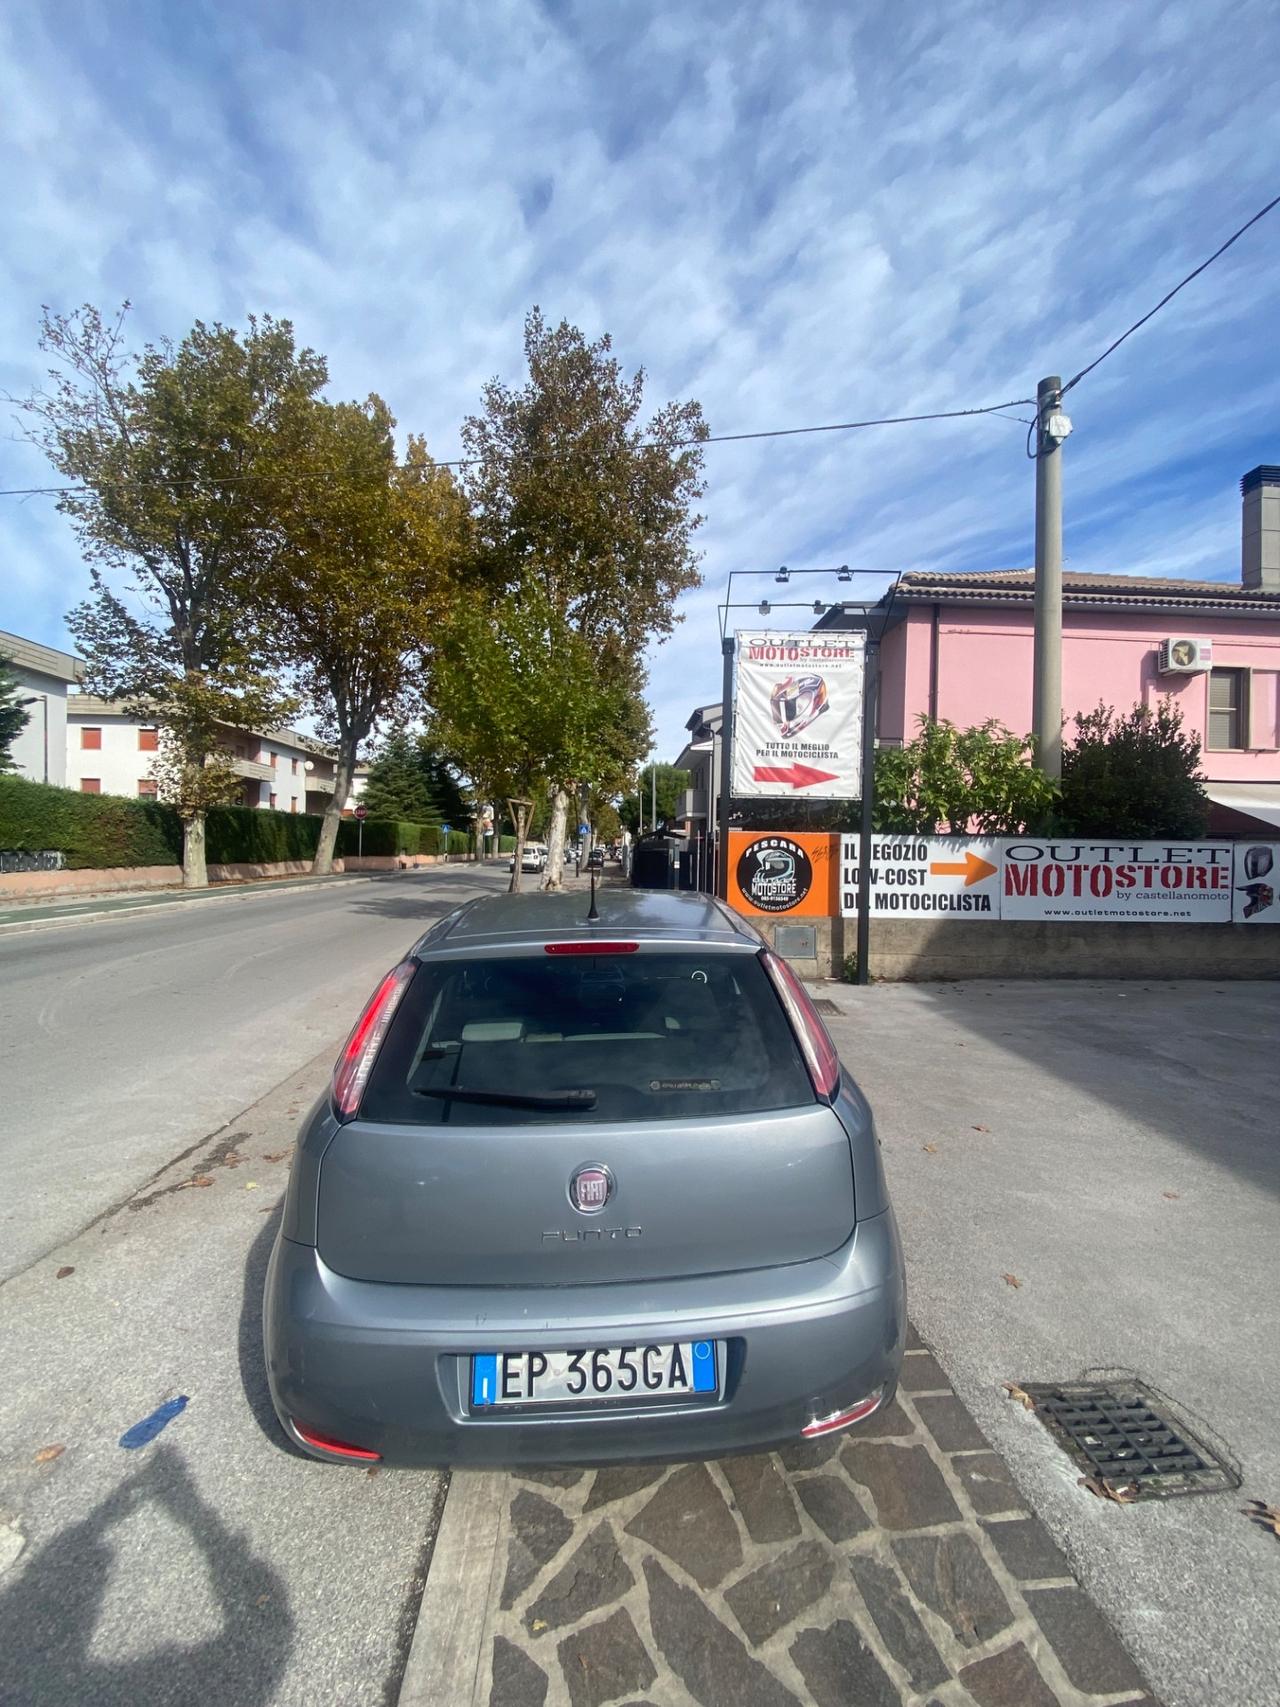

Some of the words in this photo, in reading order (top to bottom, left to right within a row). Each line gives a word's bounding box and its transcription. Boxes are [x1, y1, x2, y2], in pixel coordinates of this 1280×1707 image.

[749, 638, 855, 648] OUTLET
[749, 646, 855, 661] MOTOSTORE
[756, 749, 771, 757] PER
[781, 750, 839, 759] MOTOCICLISTA
[766, 742, 790, 750] TUTTO
[800, 743, 830, 751] MEGLIO
[745, 839, 804, 858] PESCARA
[844, 844, 858, 860] IL
[871, 843, 928, 861] EGOZIO
[1005, 845, 1230, 864] OUTLET
[1005, 863, 1230, 898] MOTOSTORE
[751, 883, 797, 896] MOTOSTORE
[1116, 890, 1131, 901] by
[1136, 889, 1230, 901] castellanomoto
[875, 893, 991, 912] MOTOCICLISTA
[1044, 909, 1192, 917] www.outletmotostore.net
[580, 1179, 604, 1201] FIAT
[541, 1226, 641, 1243] PUNTO
[501, 1352, 548, 1398] EP
[566, 1342, 688, 1394] 365GA
